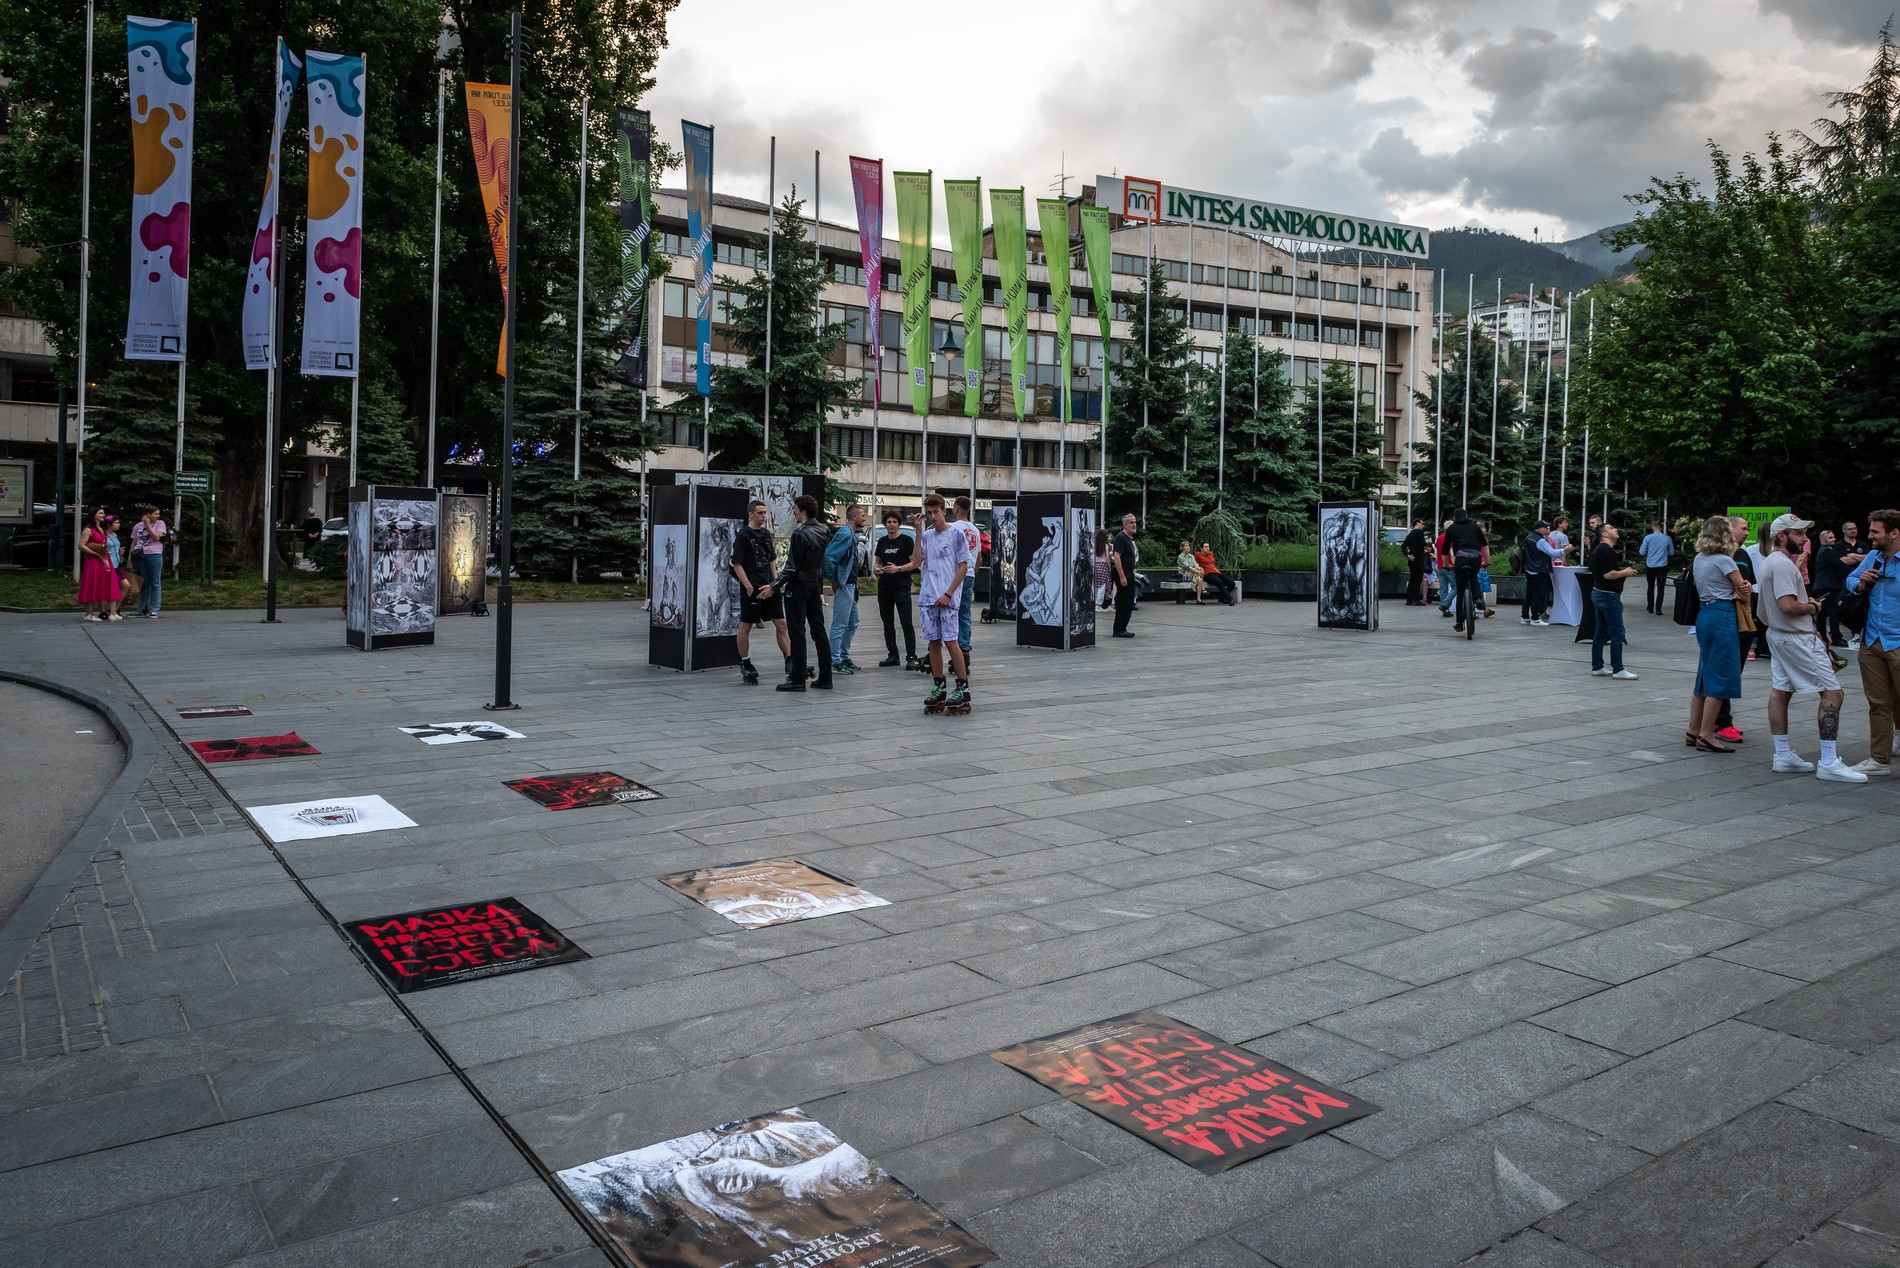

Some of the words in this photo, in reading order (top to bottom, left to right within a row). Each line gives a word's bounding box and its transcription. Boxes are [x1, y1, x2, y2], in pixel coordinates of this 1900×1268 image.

[1167, 191, 1246, 228] INTESA
[1249, 204, 1356, 244] SANPAOLO
[1358, 222, 1426, 255] BANKA
[358, 903, 514, 938] MAJKA
[371, 914, 522, 947] HRABROST
[391, 937, 560, 977] DJECA
[1038, 1028, 1215, 1085] DJECA
[1130, 1068, 1291, 1130] HRABROST
[1162, 1084, 1349, 1156] MAJKA
[757, 1232, 885, 1268] ABROST
[769, 1232, 850, 1265] MAJKA
